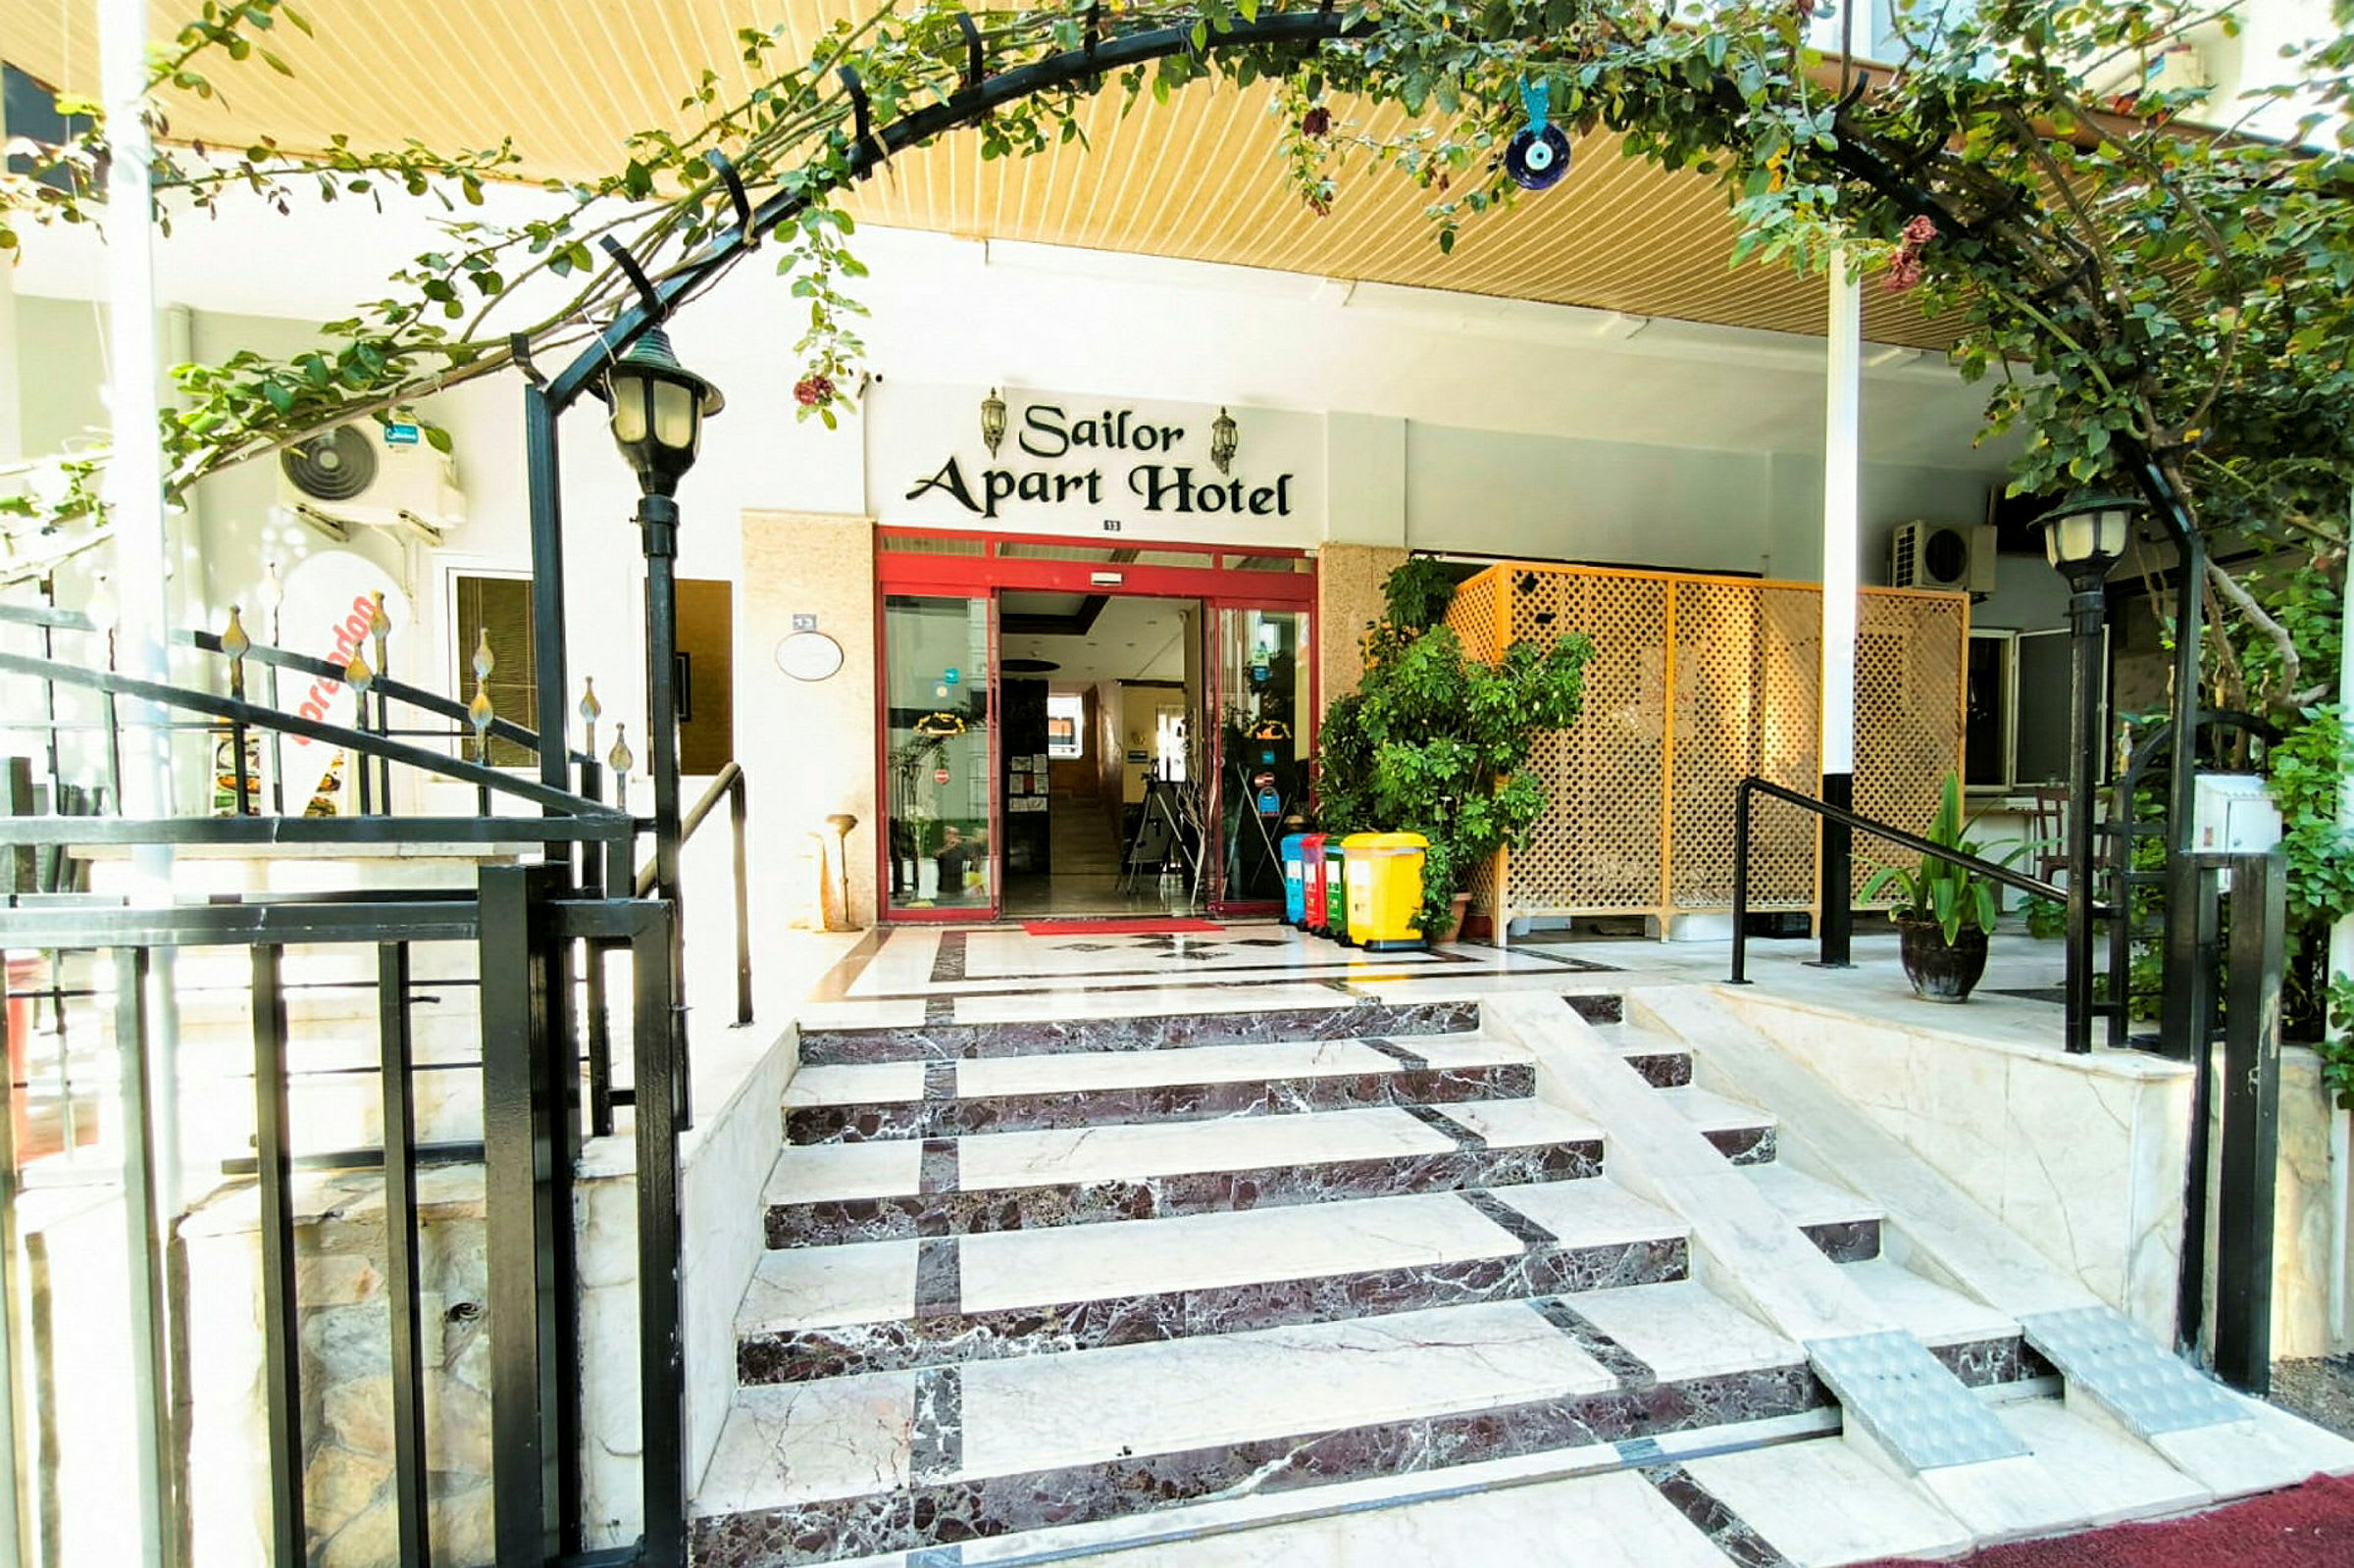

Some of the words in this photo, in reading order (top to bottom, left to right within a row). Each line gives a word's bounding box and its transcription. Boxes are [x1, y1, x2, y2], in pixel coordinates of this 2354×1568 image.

[1019, 405, 1185, 458] Sailor
[905, 455, 1103, 519] Apart
[1128, 464, 1294, 516] Hotel
